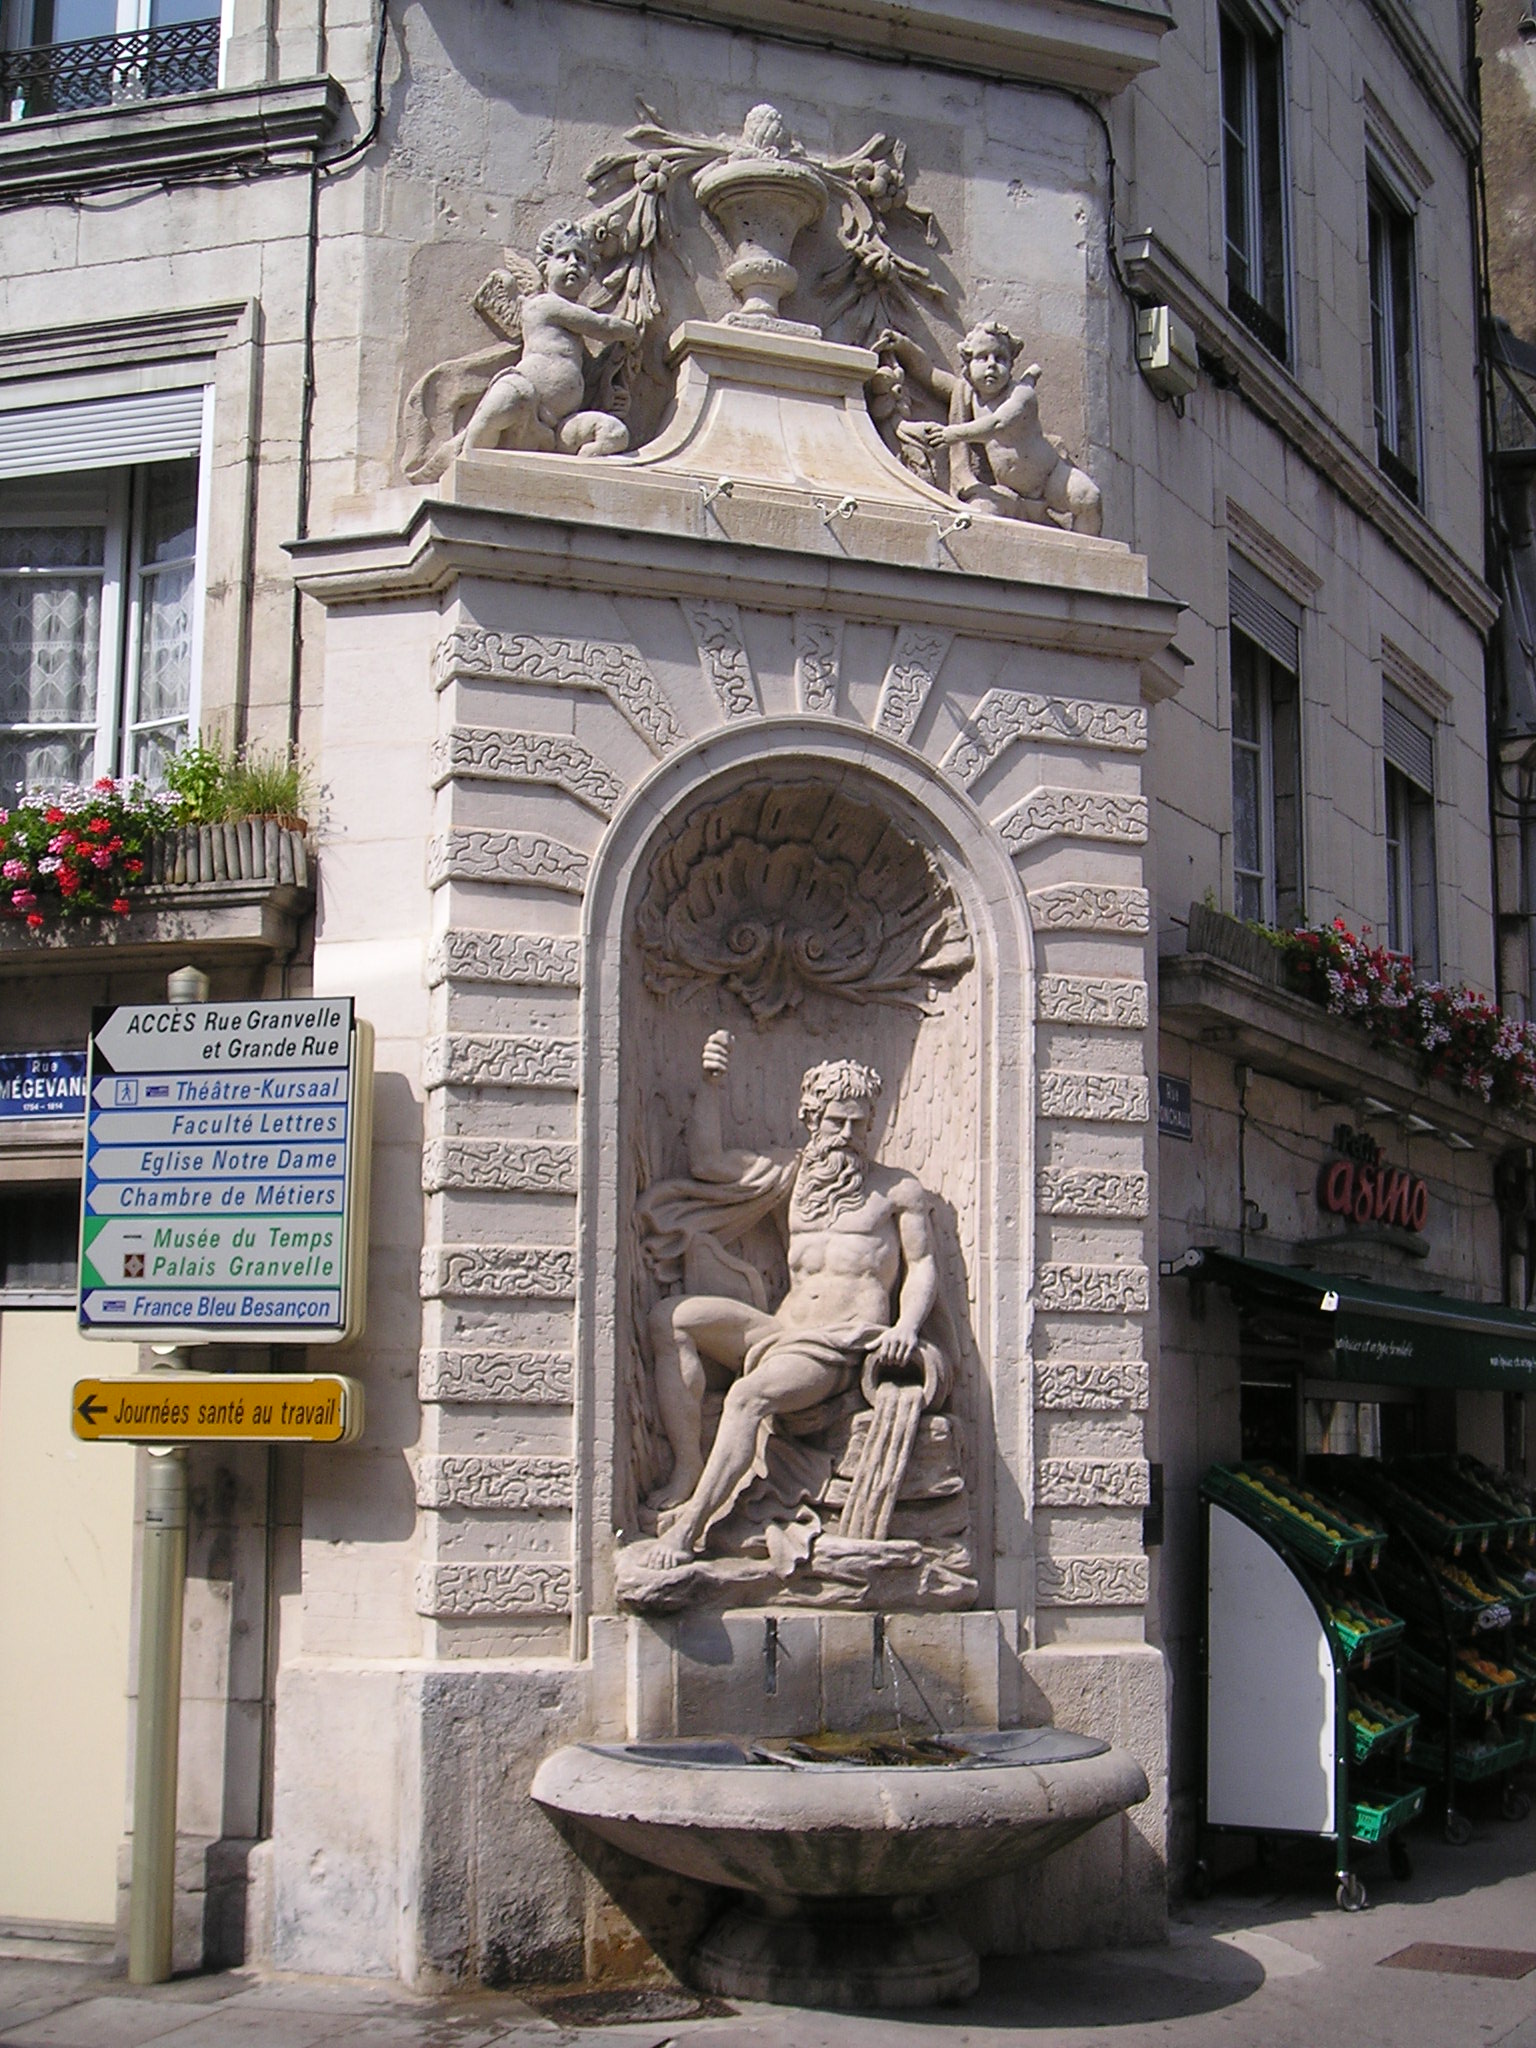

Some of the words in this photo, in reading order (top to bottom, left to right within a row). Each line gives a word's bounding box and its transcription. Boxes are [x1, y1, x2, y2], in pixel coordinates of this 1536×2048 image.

[127, 1008, 195, 1033] ACCÈS
[204, 1012, 241, 1031] Rue
[247, 1008, 341, 1029] Granvelle
[202, 1042, 220, 1059] et
[228, 1039, 296, 1057] Grande
[302, 1037, 338, 1055] Rue
[32, 1060, 58, 1073] Rue
[176, 1078, 338, 1100] Théâtre-Kursaal
[172, 1114, 252, 1134] Faculté
[260, 1114, 337, 1132] Lettres
[141, 1152, 203, 1176] Eglise
[212, 1151, 268, 1169] Notre
[277, 1150, 336, 1168] Dame
[120, 1188, 211, 1206] Chambre
[221, 1187, 245, 1206] de
[255, 1186, 335, 1205] Métiers
[154, 1228, 220, 1248] Musée
[232, 1228, 255, 1247] du
[269, 1227, 333, 1251] Temps
[152, 1257, 216, 1276] Palais
[229, 1256, 332, 1276] Granvelle
[133, 1297, 192, 1316] France
[197, 1297, 235, 1316] Bleu
[240, 1298, 330, 1318] Besançon
[114, 1398, 189, 1424] Journées
[197, 1399, 243, 1424] santé
[252, 1406, 272, 1424] au
[281, 1399, 334, 1424] travail
